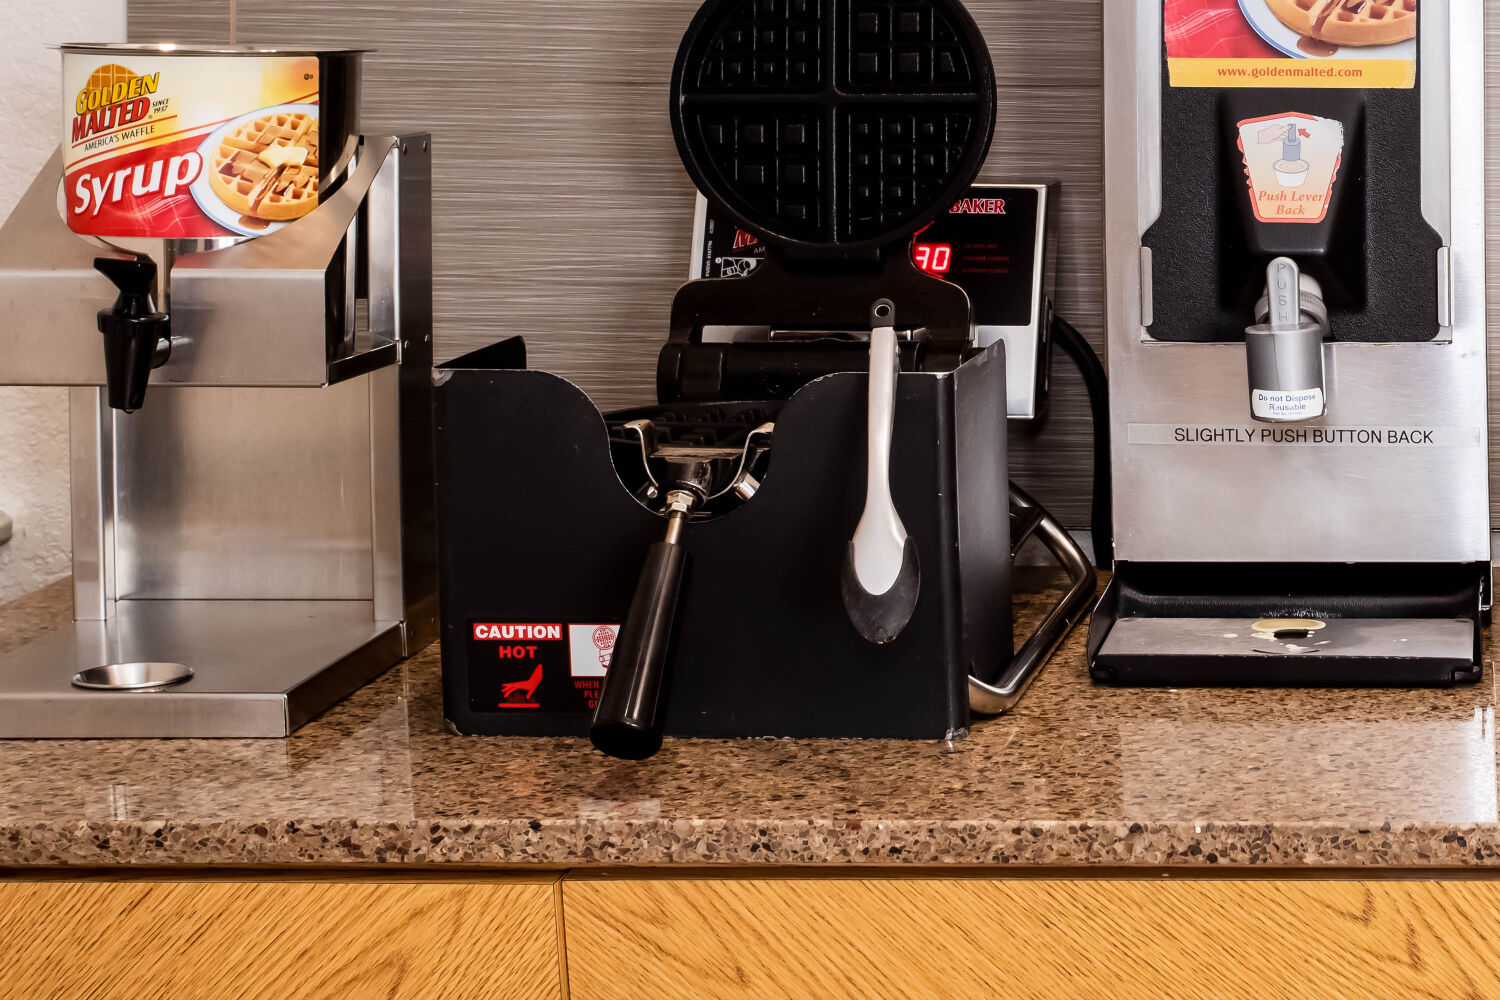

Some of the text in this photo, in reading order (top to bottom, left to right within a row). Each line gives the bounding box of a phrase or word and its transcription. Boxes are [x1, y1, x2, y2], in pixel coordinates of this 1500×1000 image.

[1217, 66, 1363, 79] www.goldenmalted.com
[76, 71, 160, 116] GOLDEN
[152, 98, 169, 108] SINCE
[72, 96, 151, 144] MALTED
[84, 124, 156, 152] AMERICA'S WAFFLE
[74, 151, 200, 214] Syrup
[1258, 190, 1324, 202] Push Lever
[949, 198, 1006, 215] BAKER
[1276, 205, 1305, 216] Back
[1277, 262, 1288, 321] PUSH
[1286, 394, 1316, 402] Dispose
[1174, 427, 1434, 444] SLIGHTLY PUSH BUTTON BACK
[475, 625, 561, 639] CAUTION
[499, 646, 538, 659] HOT
[574, 680, 599, 688] WHEN
